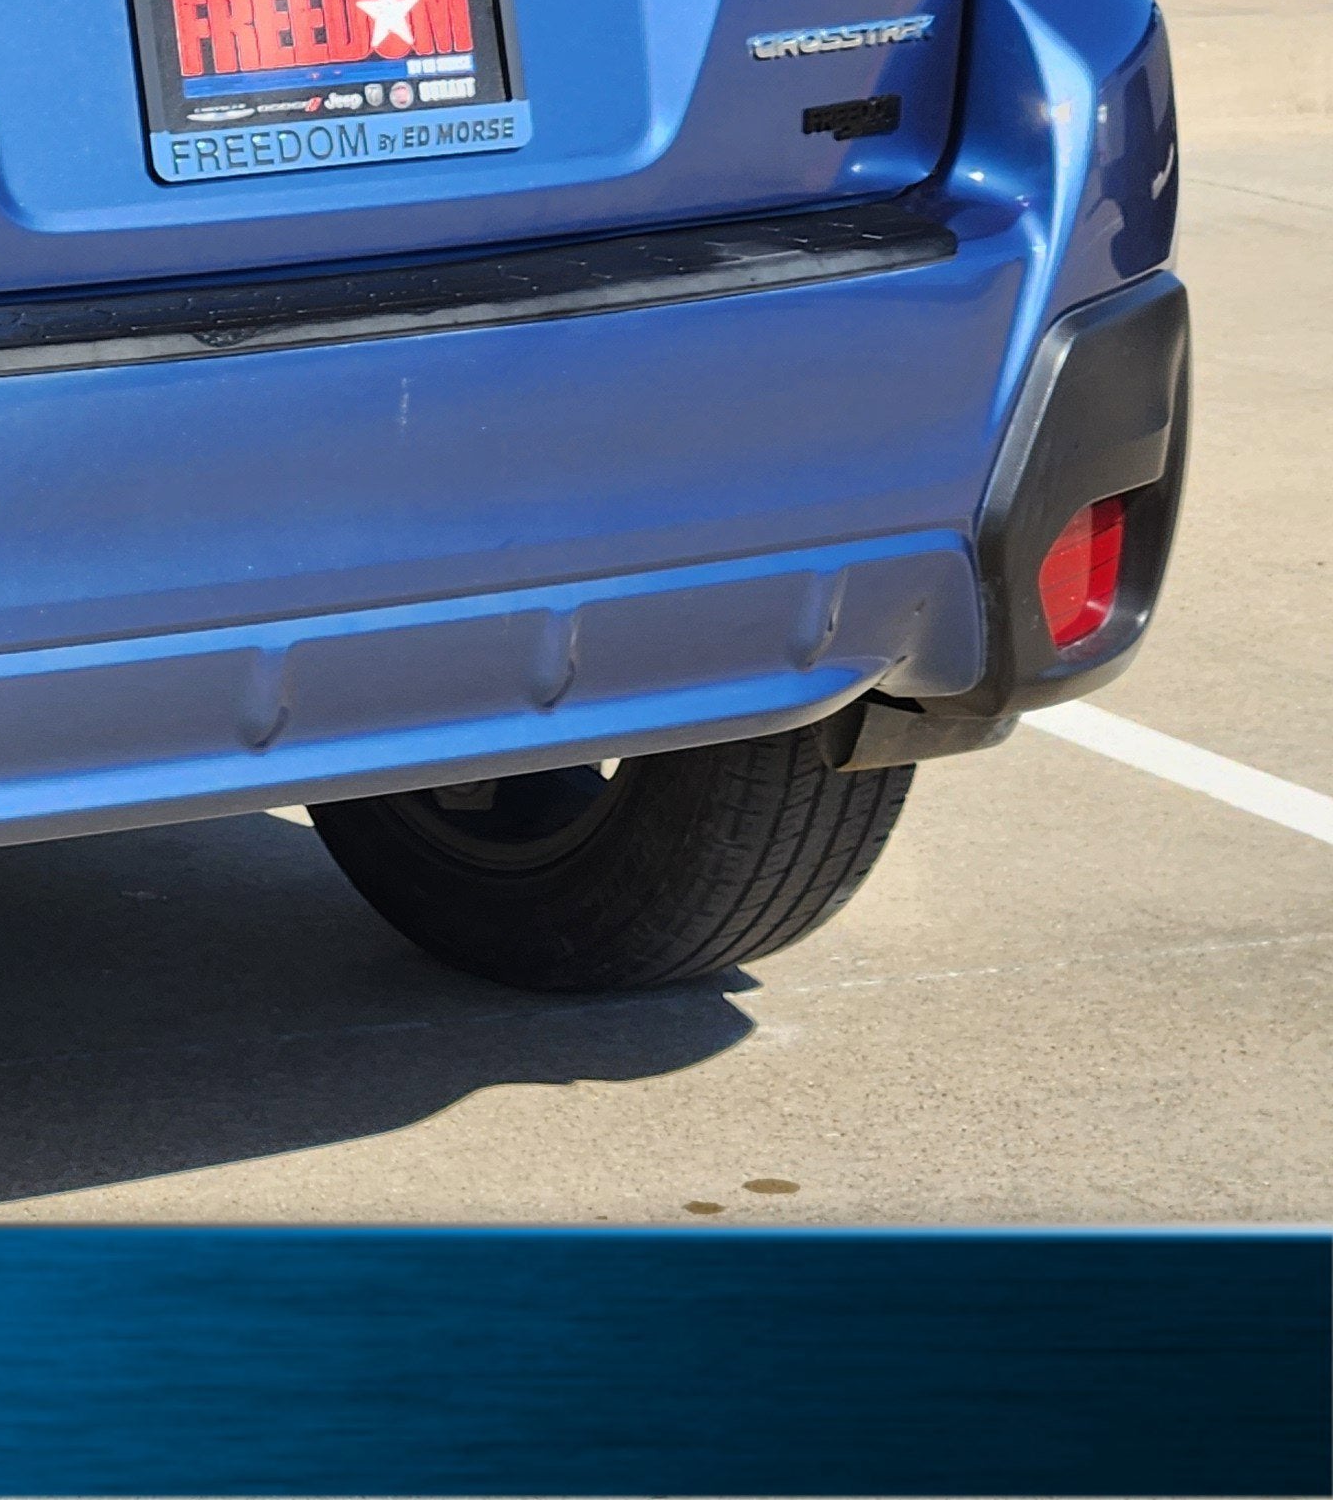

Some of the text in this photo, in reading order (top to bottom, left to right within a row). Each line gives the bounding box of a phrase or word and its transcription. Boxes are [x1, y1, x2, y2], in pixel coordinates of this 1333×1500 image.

[171, 122, 370, 175] FREEDOM
[402, 125, 430, 148] ED
[436, 116, 515, 145] MORSE
